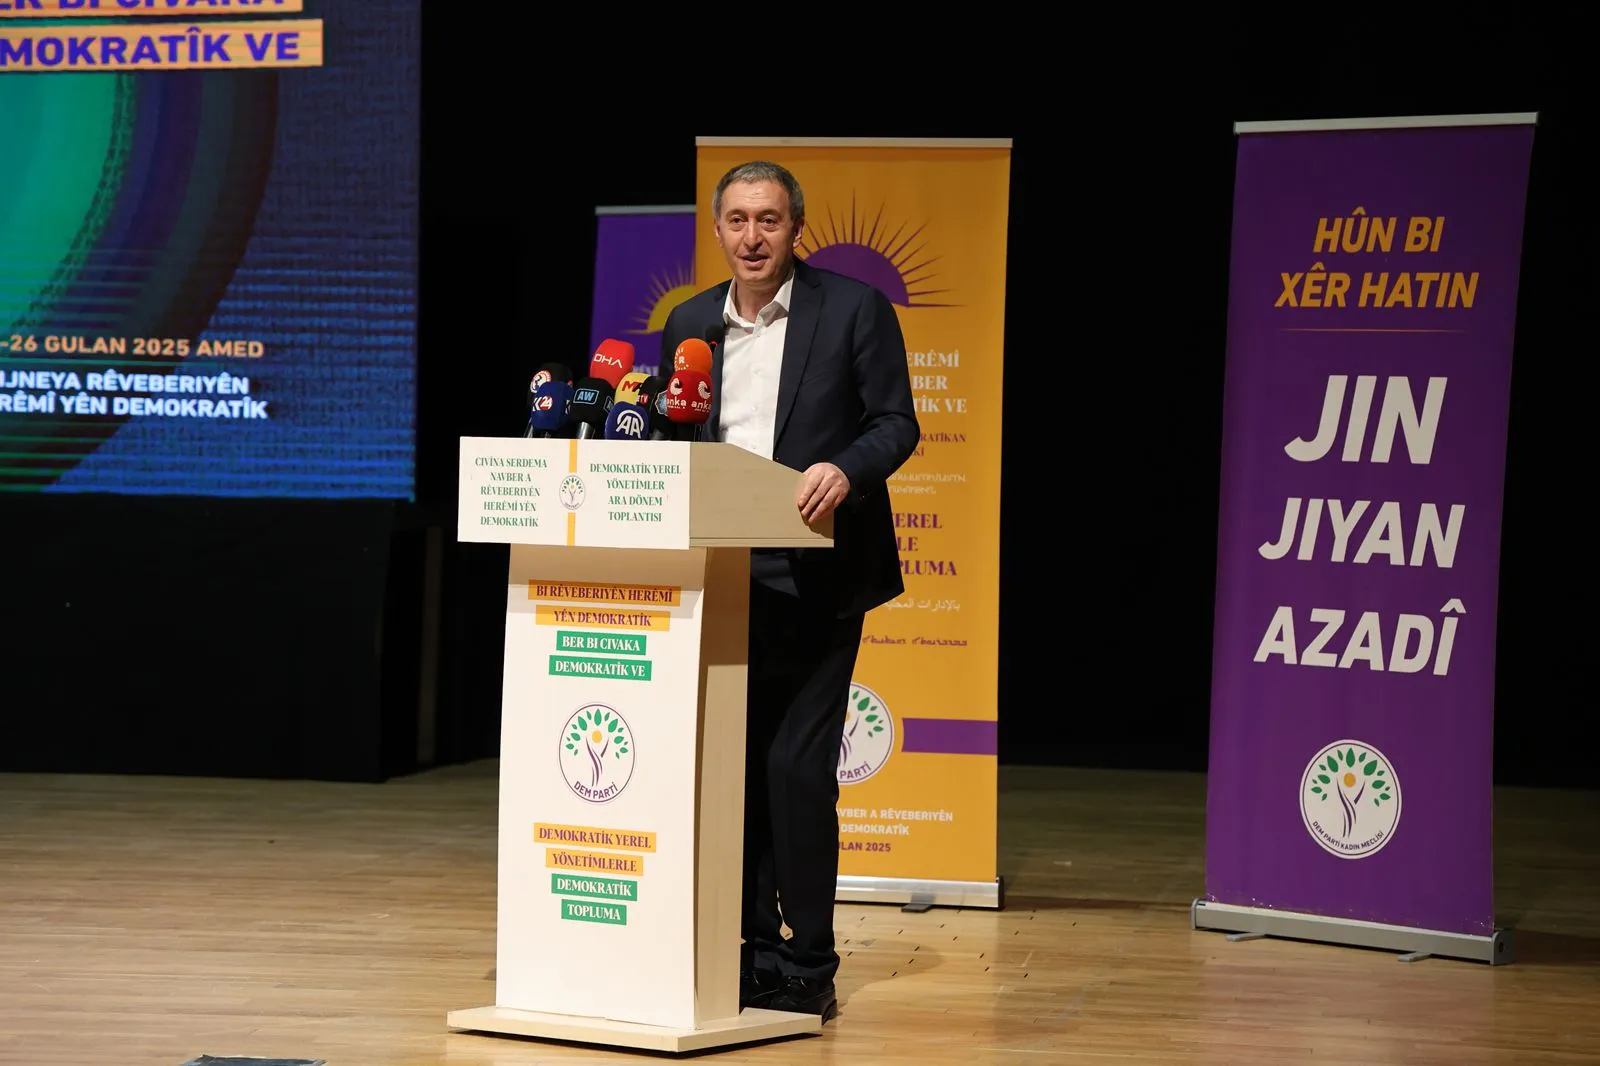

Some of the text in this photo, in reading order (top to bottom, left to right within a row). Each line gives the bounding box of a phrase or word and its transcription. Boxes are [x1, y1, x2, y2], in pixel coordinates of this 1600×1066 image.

[0, 26, 299, 66] MOKRATÎK VE
[1313, 206, 1445, 253] HÛN BI
[1274, 261, 1479, 308] XÊR HATIN
[45, 335, 126, 354] GULAN
[132, 338, 190, 357] 2025
[196, 340, 264, 358] AMED
[86, 369, 249, 394] RÊVEBERIYÊN
[912, 375, 948, 390] BER
[60, 391, 107, 415] YÊN
[113, 396, 267, 419] DEMOKRATÎK
[577, 390, 596, 402] AW
[943, 398, 967, 413] VE
[1284, 374, 1448, 464] JIN
[652, 464, 682, 475] YEREL
[606, 478, 665, 490] YÖNETİMLER
[608, 494, 663, 506] ARA DÖNEM
[608, 511, 663, 522] TOPLANTISI
[1258, 497, 1466, 569] JIYAN
[536, 584, 673, 603] BI RÊVEBERIYÊN HERÊMÎ
[553, 609, 575, 623] YÊN
[562, 636, 641, 651] BER BI CIVAKA
[1253, 598, 1467, 676] AZADÎ
[631, 665, 645, 677] VE
[839, 761, 872, 780] PARTİ
[573, 781, 619, 800] DEM PARTİ
[869, 809, 878, 818] A
[539, 827, 651, 849] DEMOKRATİK YEREL
[1312, 821, 1325, 834] DEM
[1340, 843, 1360, 851] KADIN
[865, 842, 892, 853] 2025
[552, 851, 637, 872] YÖNETİMLERLE
[557, 878, 632, 897] DEMOKRATİK
[567, 904, 621, 921] TOPLUMA
